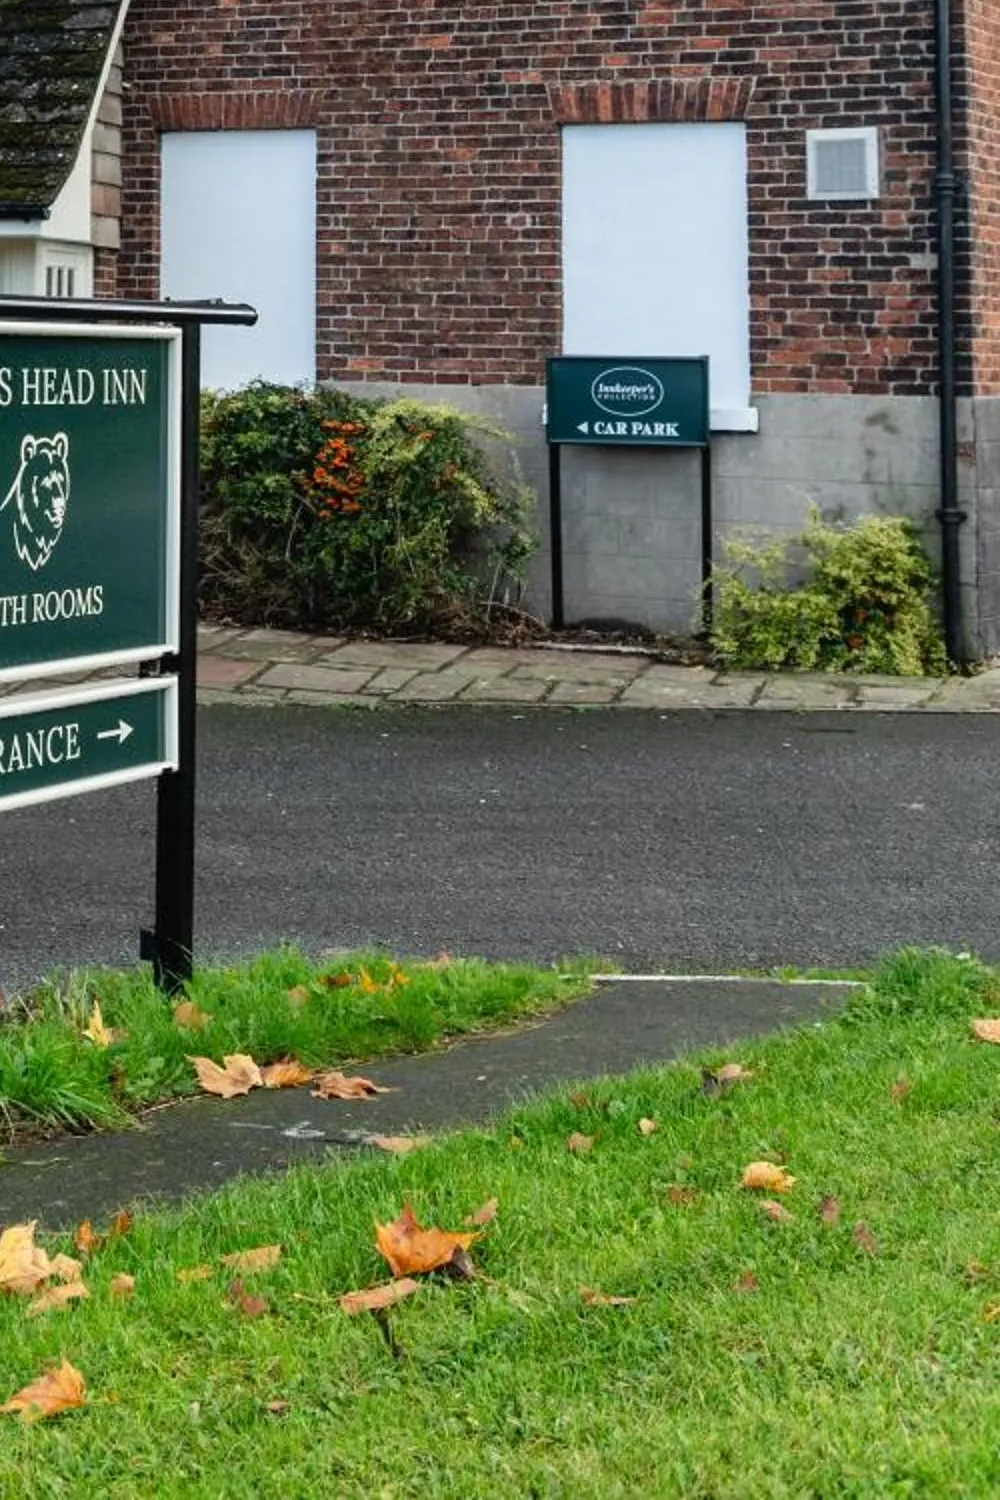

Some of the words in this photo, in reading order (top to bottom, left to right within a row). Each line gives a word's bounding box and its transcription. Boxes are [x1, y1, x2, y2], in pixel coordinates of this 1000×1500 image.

[21, 367, 96, 406] HEAD
[102, 368, 147, 405] INN
[598, 383, 655, 396] Innkeeper's
[593, 421, 628, 436] CAR
[632, 421, 680, 438] PARK
[32, 585, 104, 623] ROOMS
